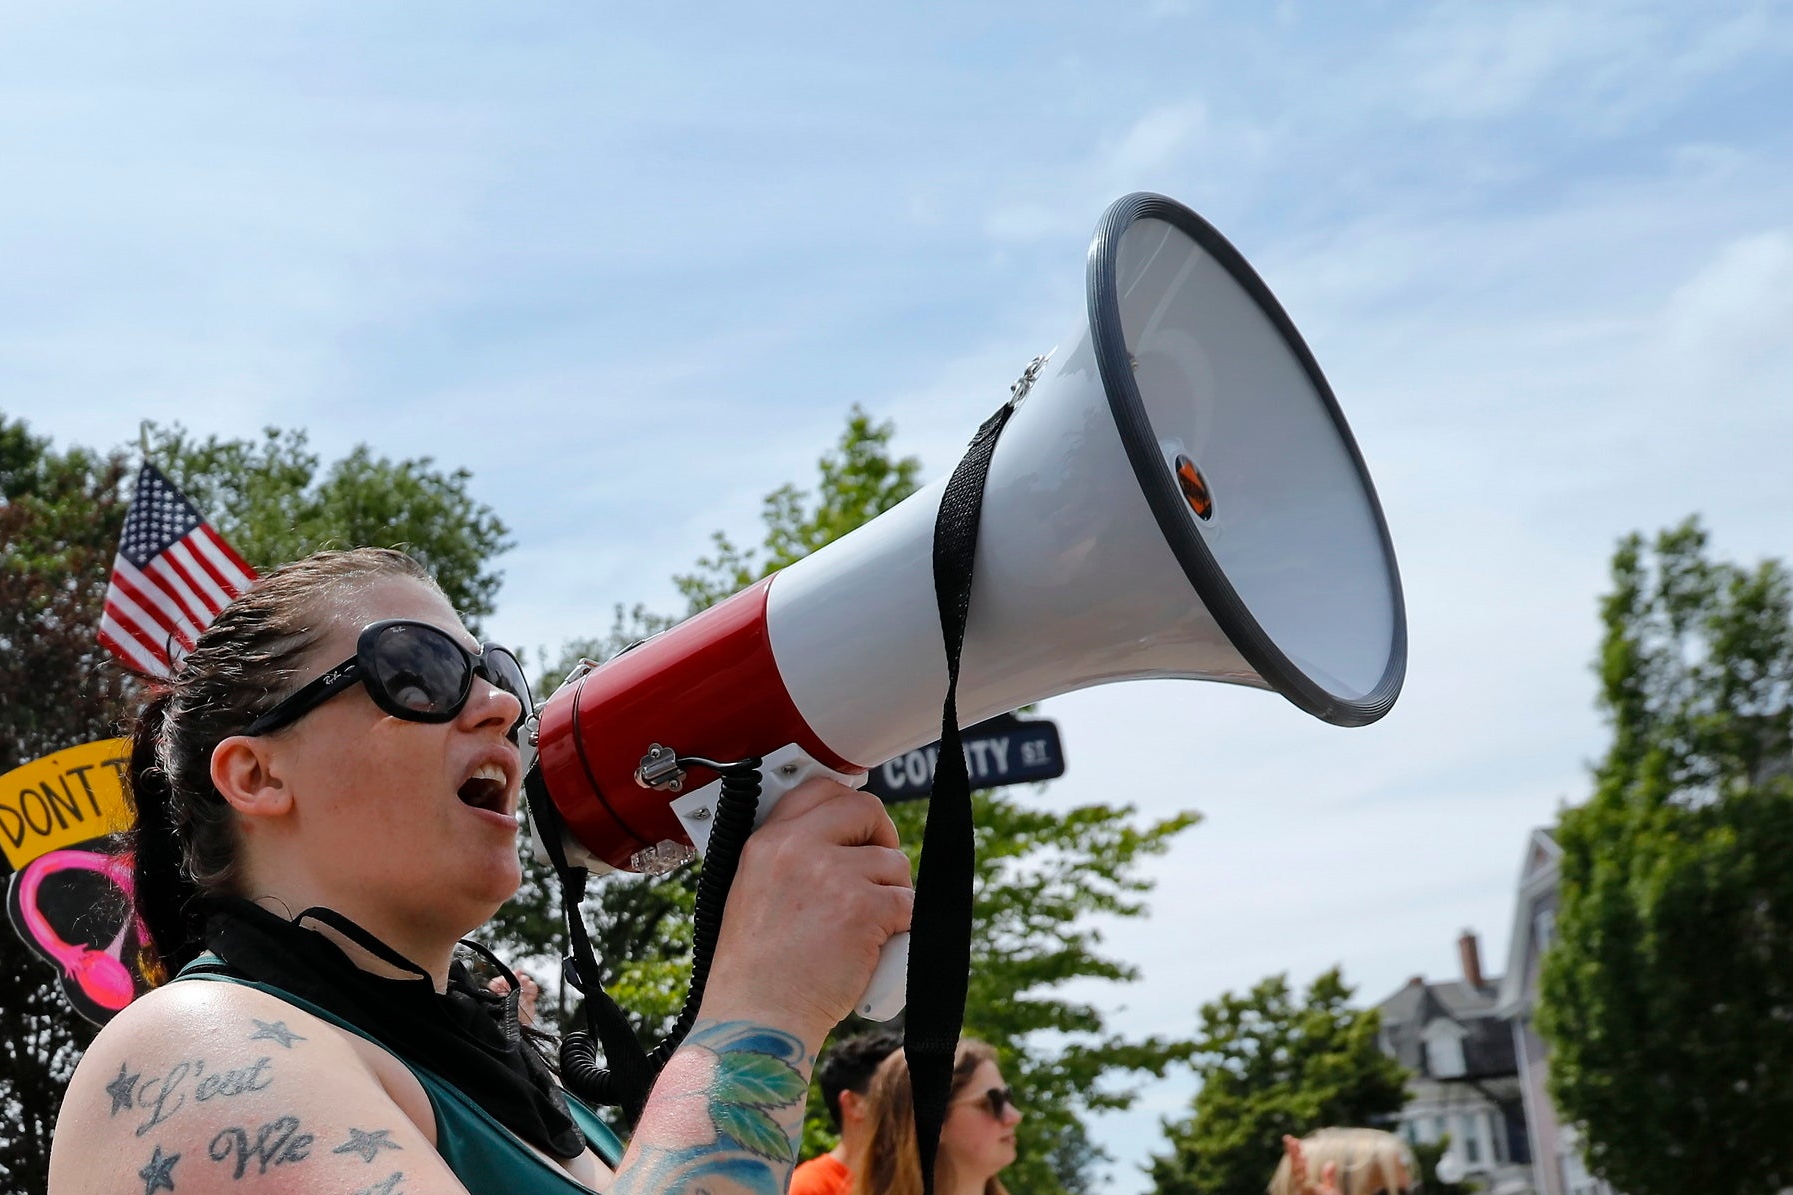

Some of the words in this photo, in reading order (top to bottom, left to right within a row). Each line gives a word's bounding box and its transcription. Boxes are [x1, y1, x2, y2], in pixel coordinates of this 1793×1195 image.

[881, 736, 1010, 790] COTY
[1020, 739, 1049, 764] ST
[209, 1116, 314, 1180] We
